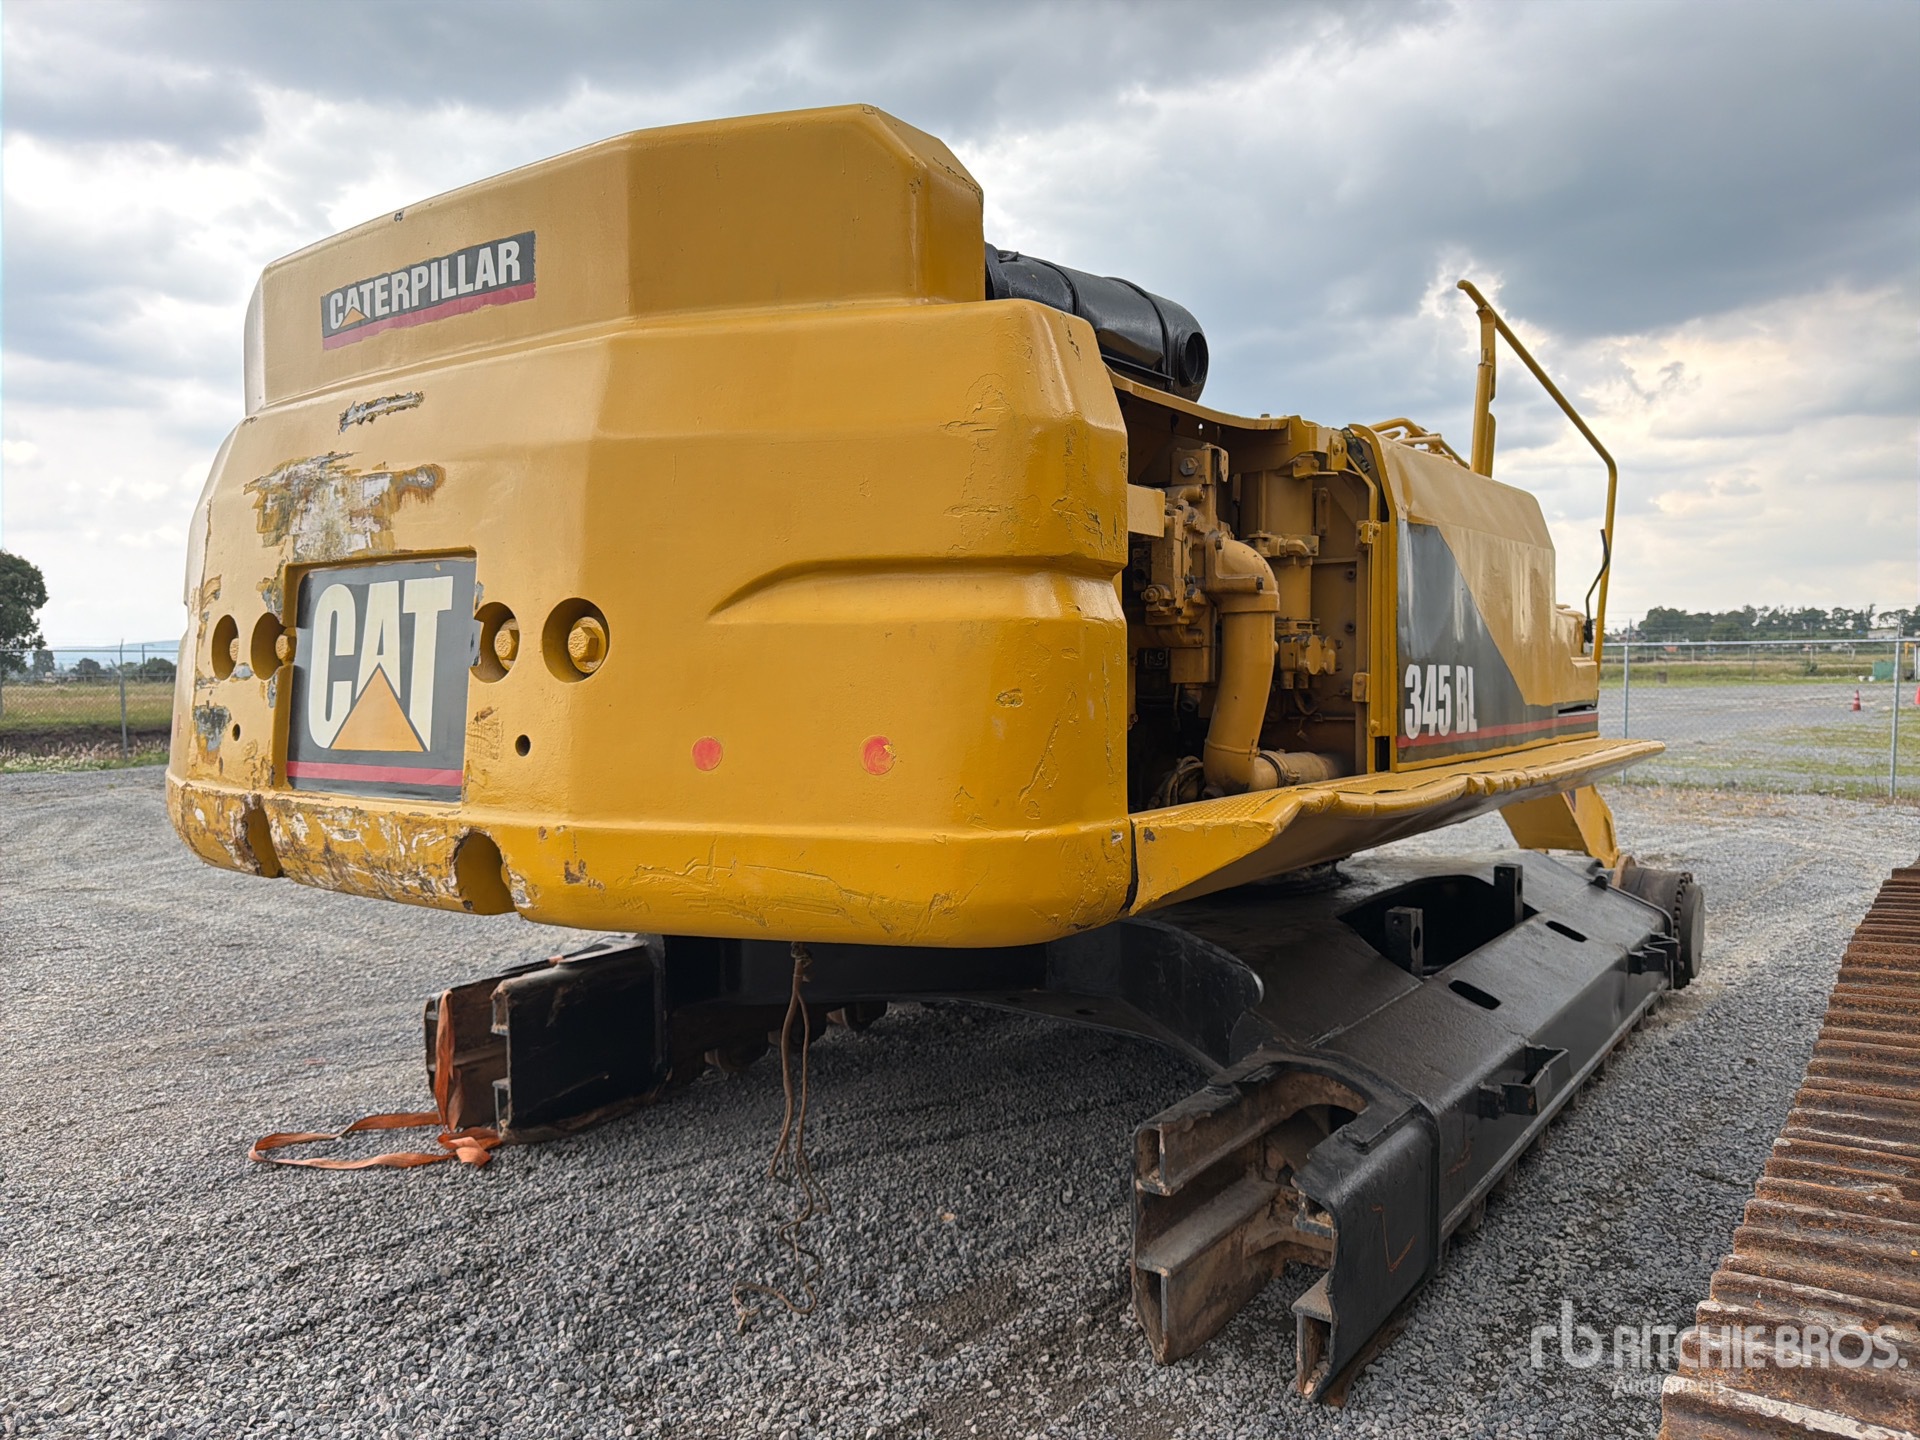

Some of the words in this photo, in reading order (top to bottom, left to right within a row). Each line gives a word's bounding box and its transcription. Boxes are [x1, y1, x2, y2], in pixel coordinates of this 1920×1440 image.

[329, 240, 521, 330] CATERPILLAR
[308, 575, 454, 752] CAT
[1404, 663, 1452, 740] 345
[1455, 665, 1478, 734] BL
